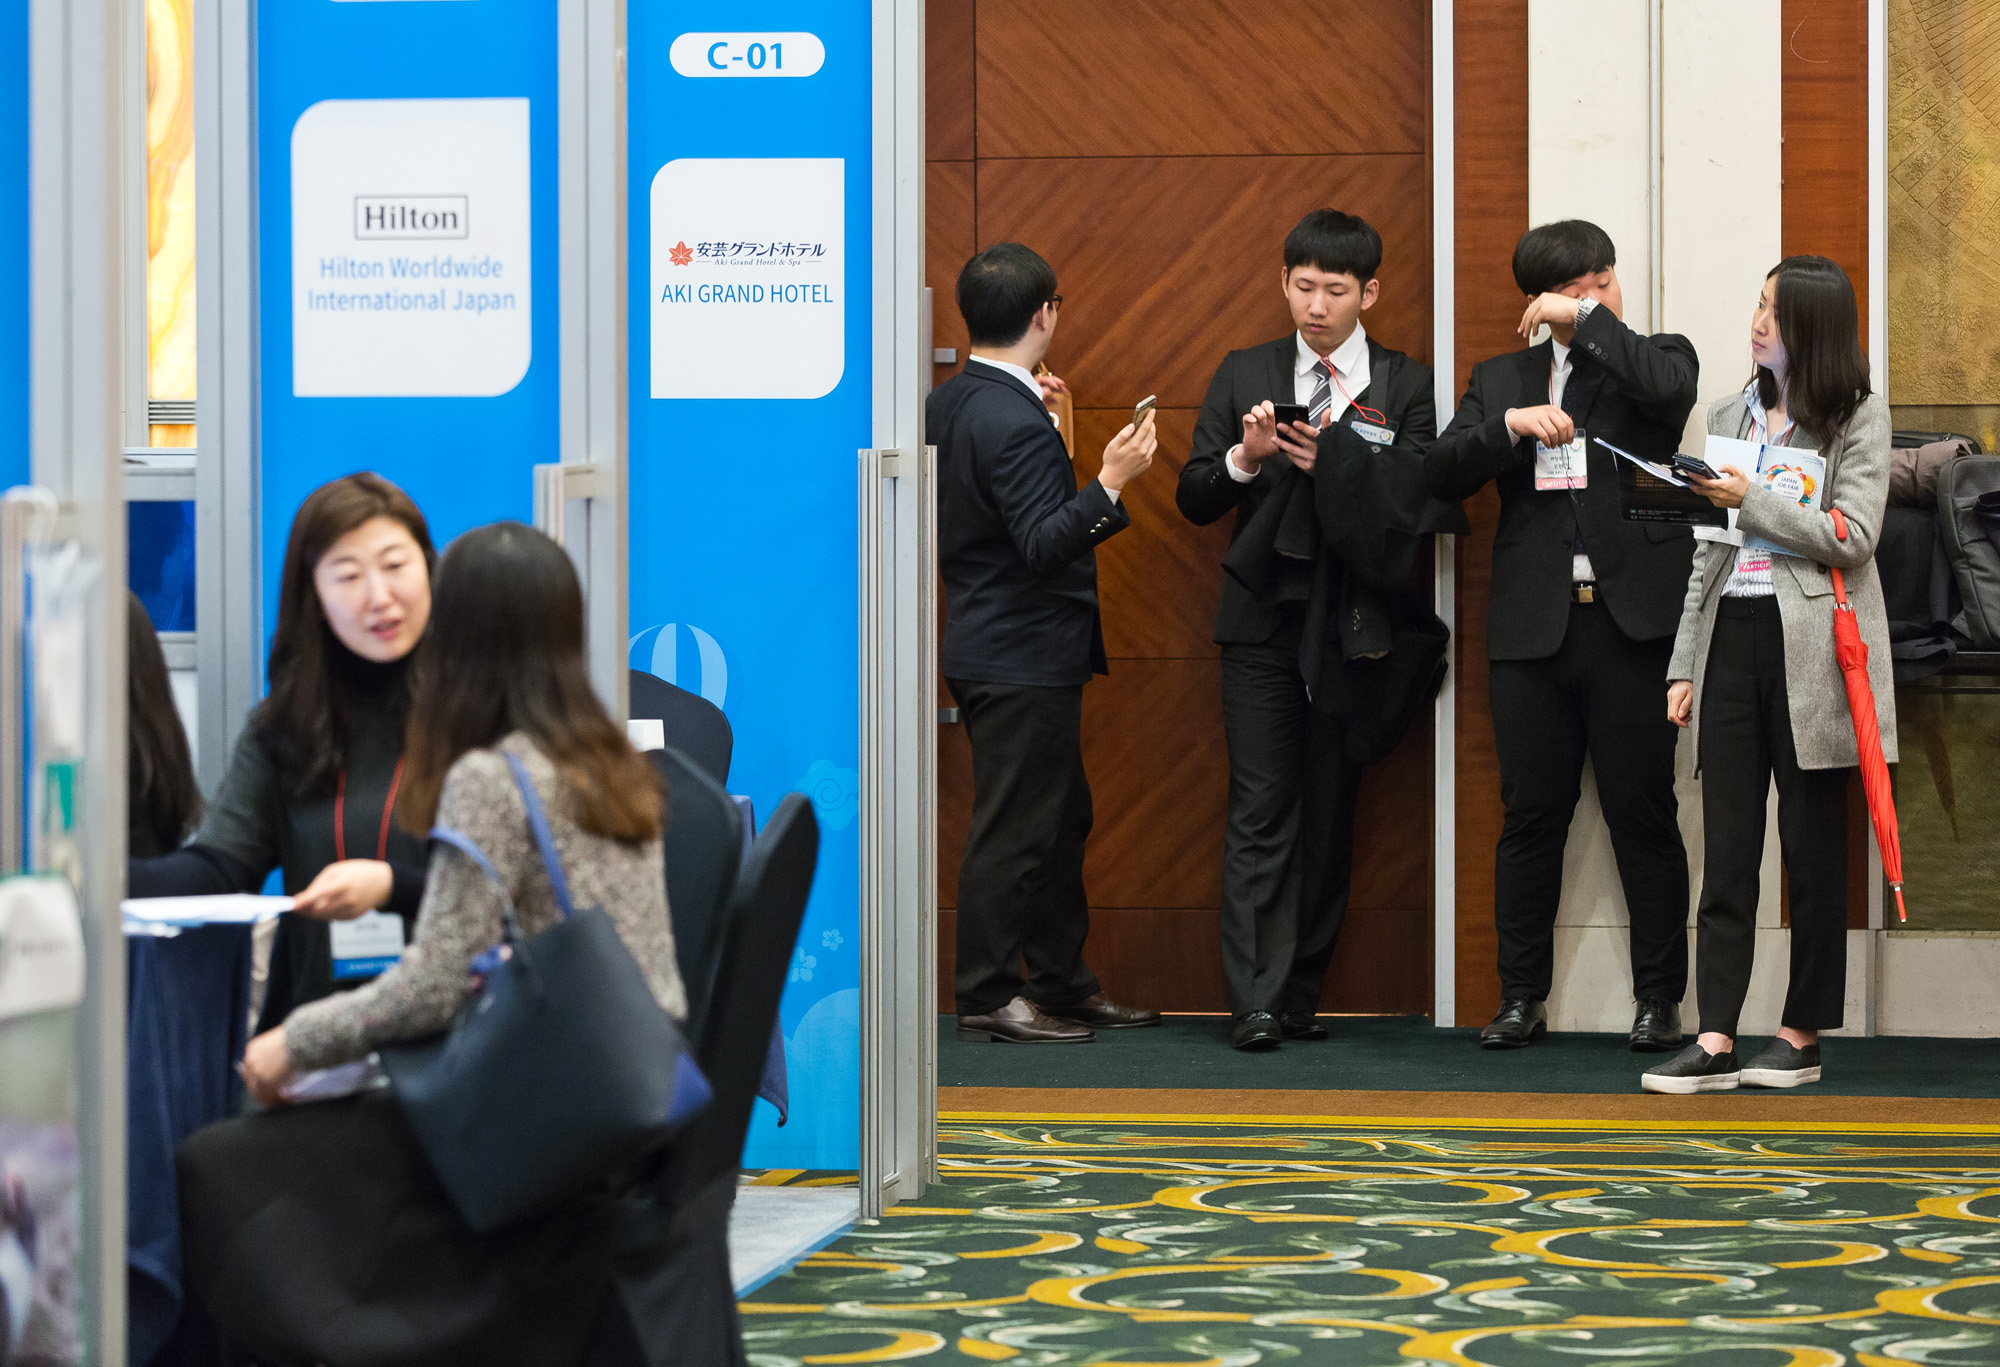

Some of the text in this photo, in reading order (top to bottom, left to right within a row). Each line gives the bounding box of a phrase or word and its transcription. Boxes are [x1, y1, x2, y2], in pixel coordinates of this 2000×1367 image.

[707, 41, 782, 70] C-01
[364, 205, 459, 231] Hilton
[696, 241, 828, 258] 安芸グランドホテル
[319, 255, 505, 279] Hilton Worldwide
[713, 258, 802, 267] Aki Grand Hotel & Spa
[307, 287, 517, 316] International Japan
[661, 284, 834, 304] AKI GRAND HOTEL
[1776, 481, 1787, 489] JOB
[1780, 476, 1798, 485] JAPAN
[1742, 562, 1770, 571] PARTICIP
